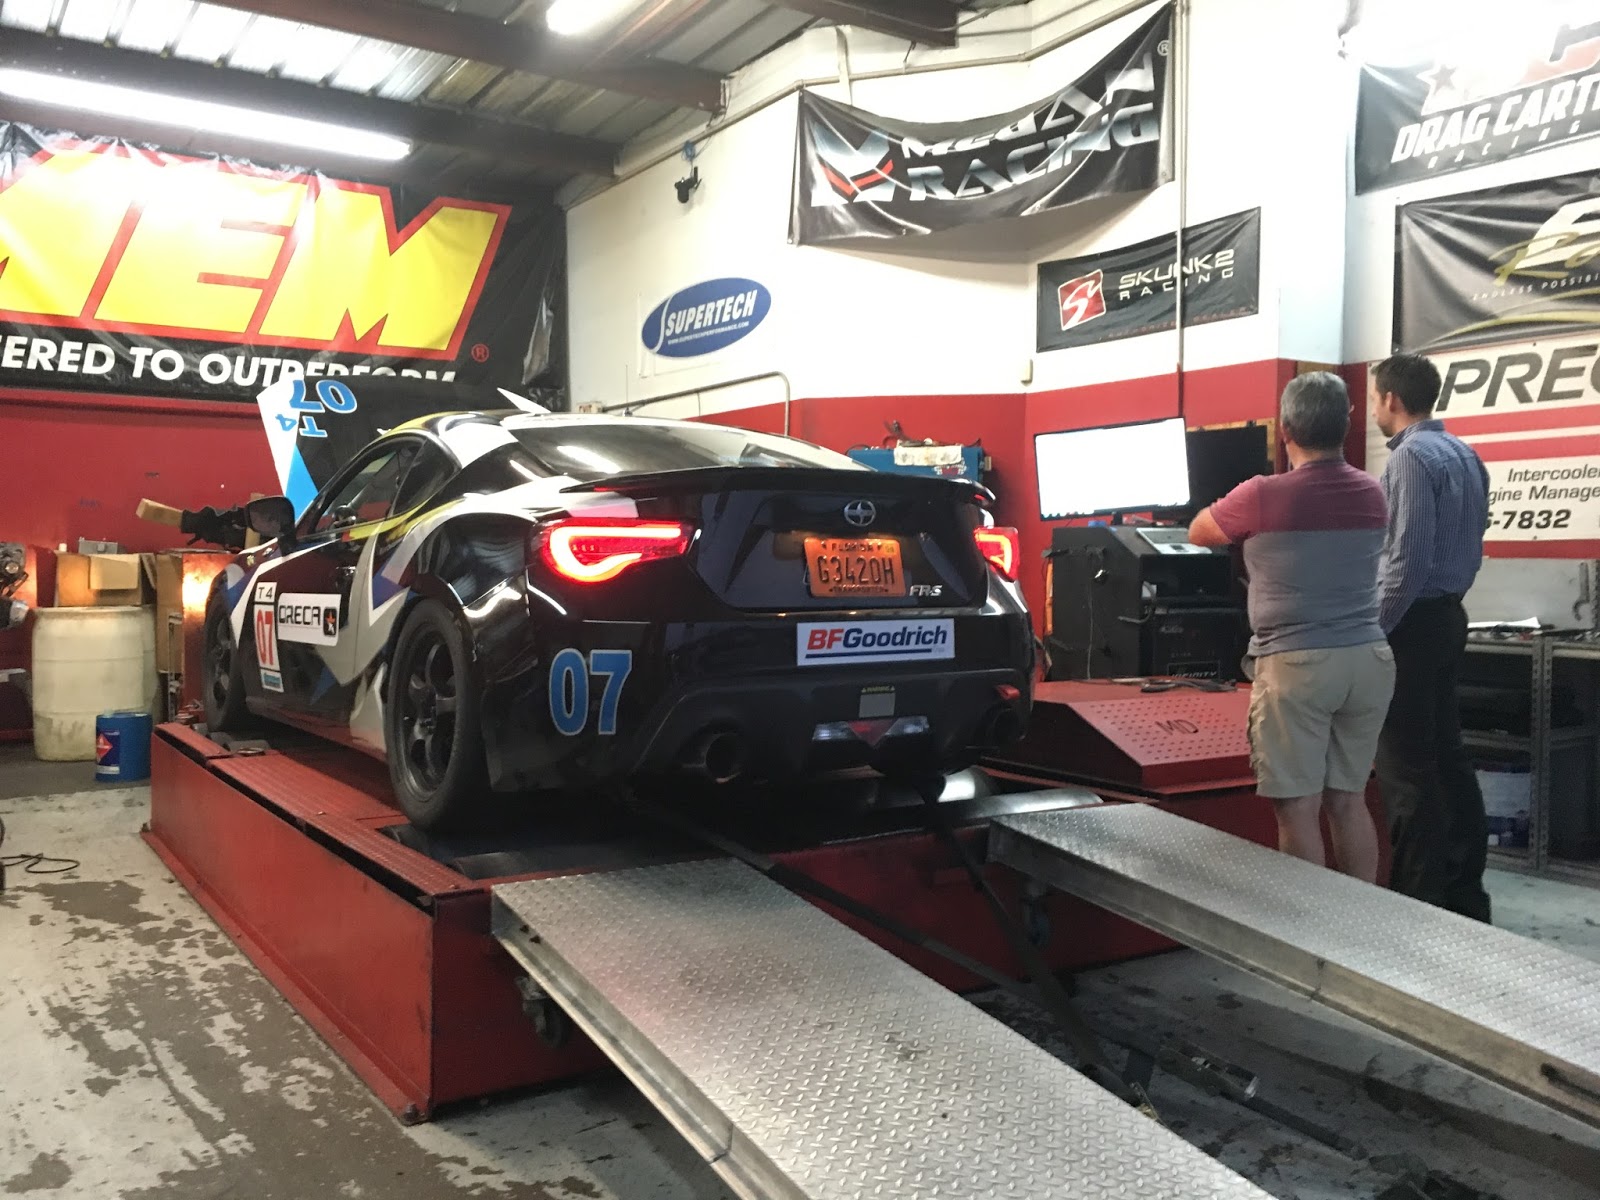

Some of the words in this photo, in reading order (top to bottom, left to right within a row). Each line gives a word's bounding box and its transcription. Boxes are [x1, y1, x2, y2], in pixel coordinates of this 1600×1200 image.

[907, 102, 1160, 201] RACING
[1391, 103, 1491, 163] DRAG
[1119, 249, 1234, 289] SKUNK2
[1120, 268, 1234, 300] RACING
[666, 289, 757, 337] SUPERTECH
[0, 335, 116, 374] ERED
[130, 347, 184, 381] TO
[1435, 343, 1600, 412] PRE
[289, 379, 358, 415] 07
[1507, 464, 1600, 482] Intercoole
[807, 625, 947, 650] BFGoodrich
[549, 647, 632, 736] 07
